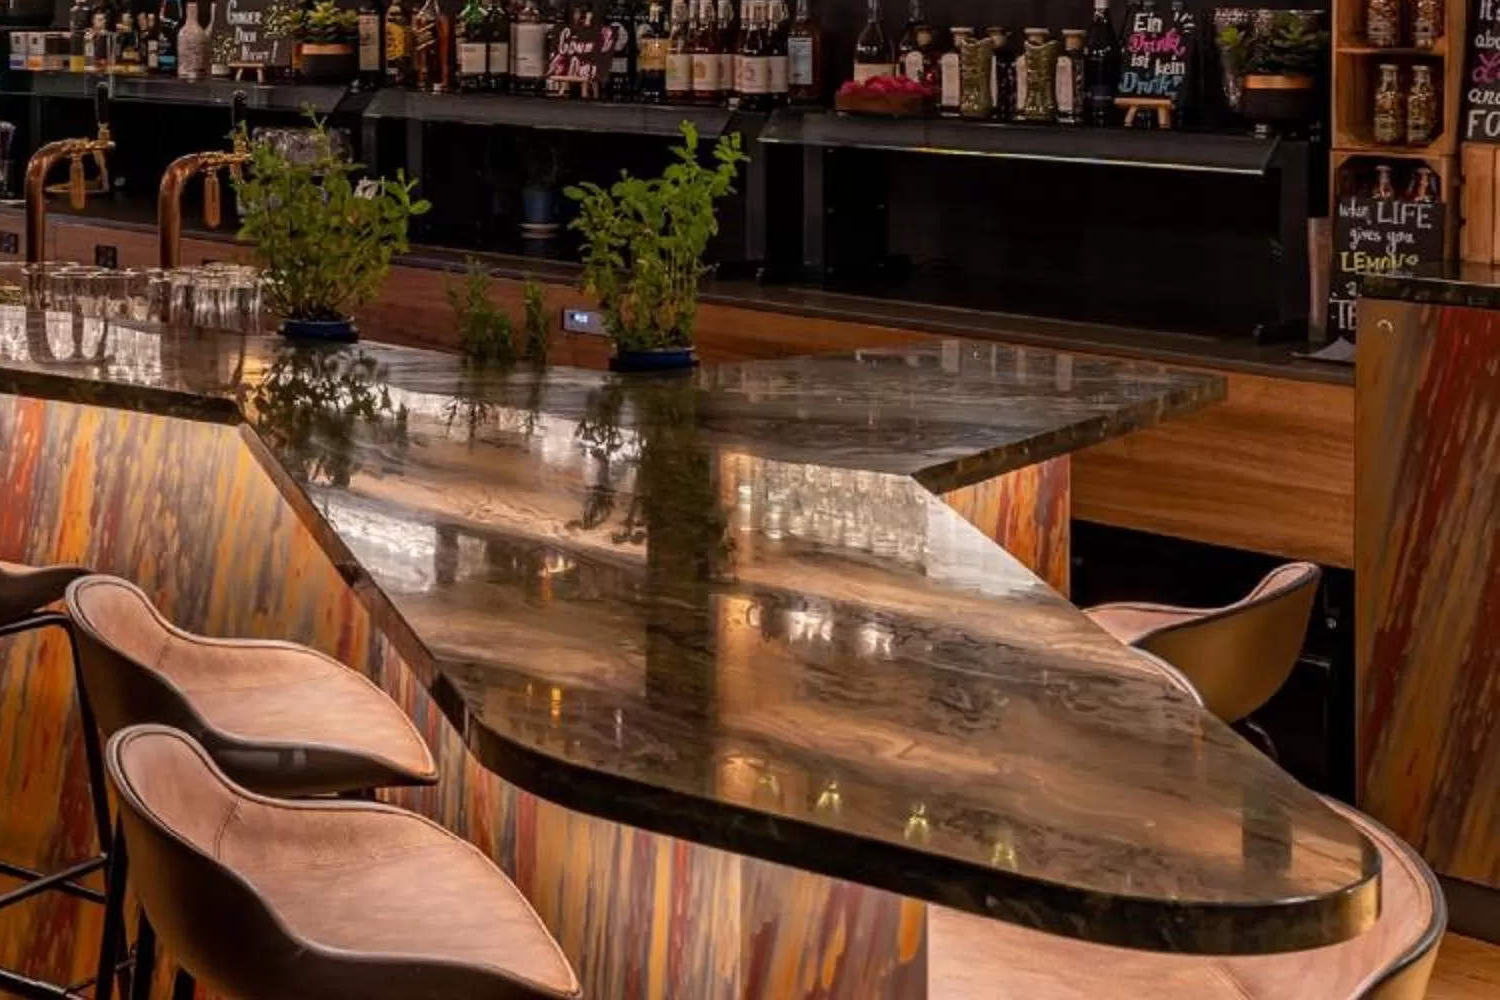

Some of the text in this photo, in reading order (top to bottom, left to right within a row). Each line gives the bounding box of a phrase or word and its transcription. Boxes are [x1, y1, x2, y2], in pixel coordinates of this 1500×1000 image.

[1133, 12, 1163, 32] Ein
[1130, 52, 1185, 76] ist kein
[1376, 201, 1433, 230] LIFE
